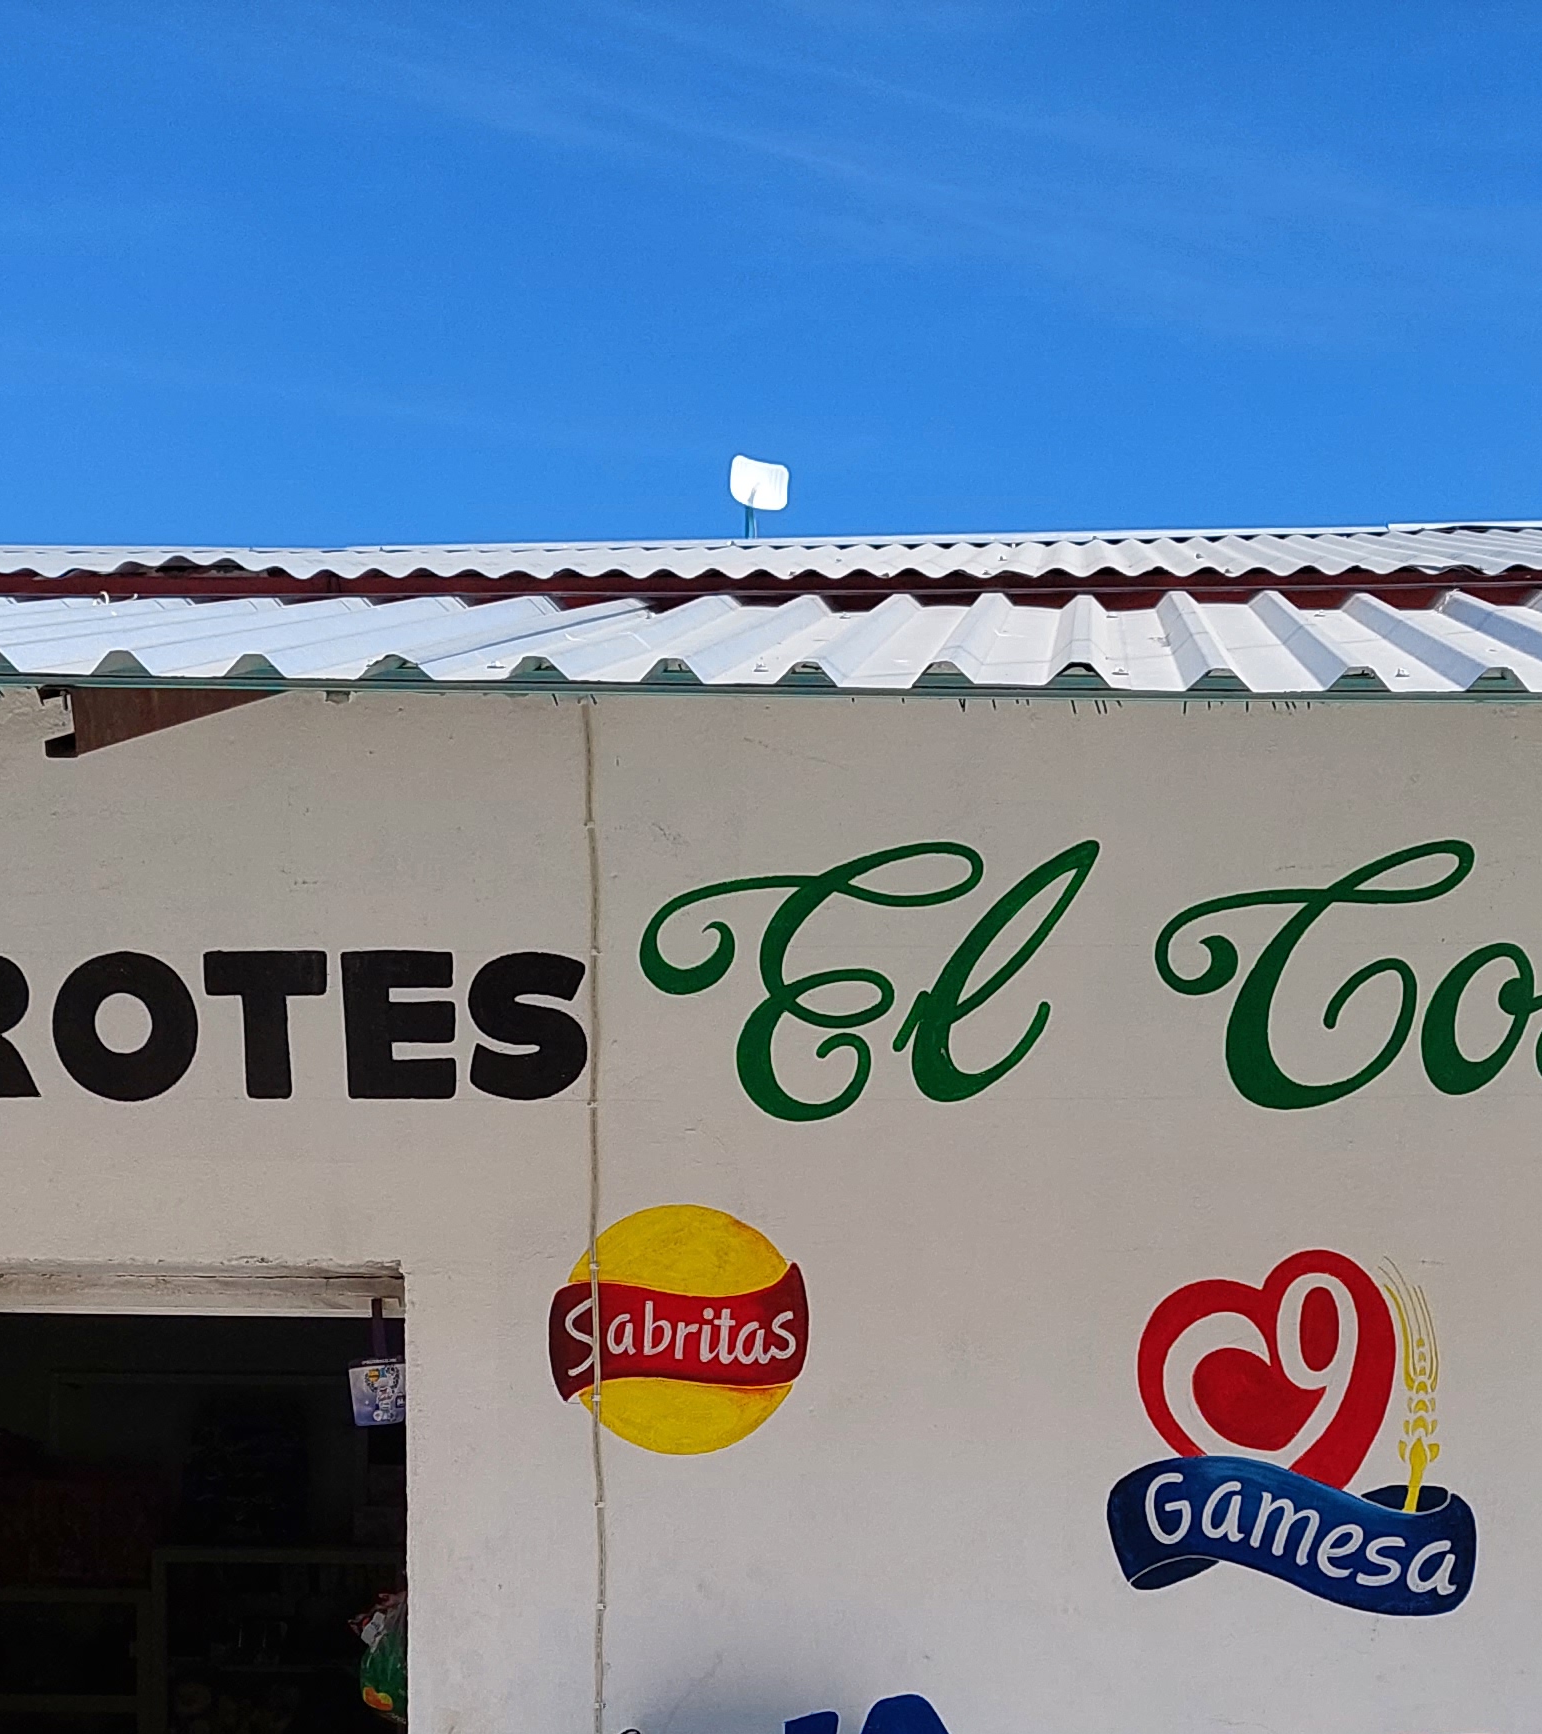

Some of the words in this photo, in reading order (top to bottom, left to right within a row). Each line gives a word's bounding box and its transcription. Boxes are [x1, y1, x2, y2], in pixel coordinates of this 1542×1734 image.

[637, 838, 1102, 1122] El
[564, 1298, 797, 1377] Sabritas
[1145, 1473, 1457, 1595] Gamesa
